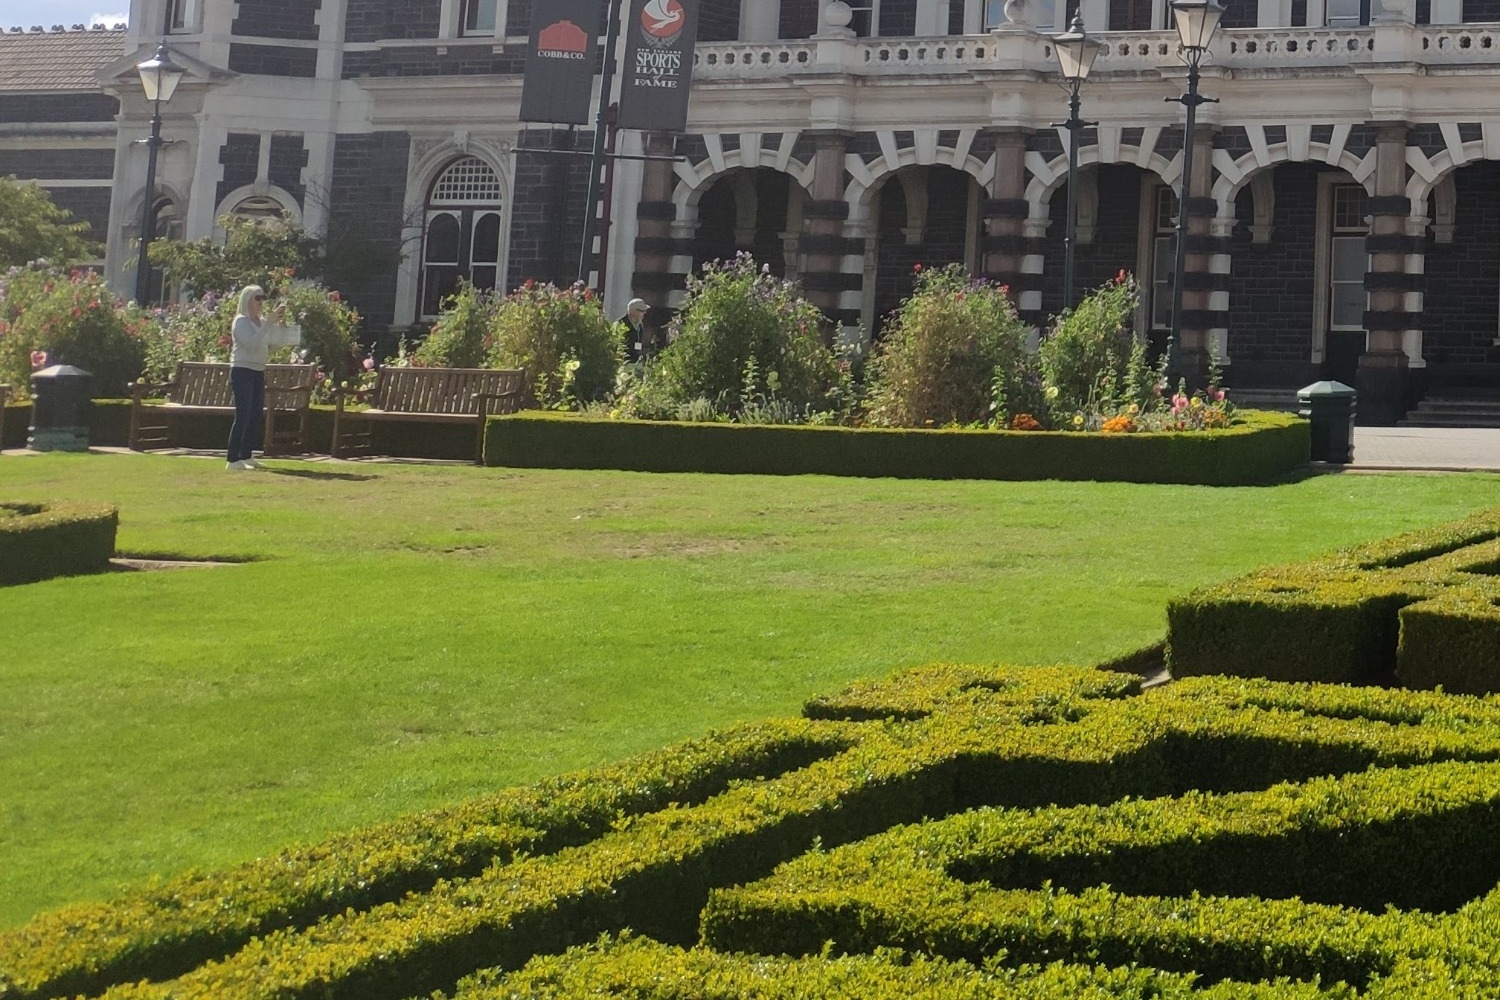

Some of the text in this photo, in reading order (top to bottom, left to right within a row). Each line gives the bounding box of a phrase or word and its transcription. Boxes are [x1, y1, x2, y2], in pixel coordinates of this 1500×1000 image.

[635, 51, 681, 69] SPORTS
[635, 66, 680, 76] HALL
[634, 78, 678, 89] FAME
